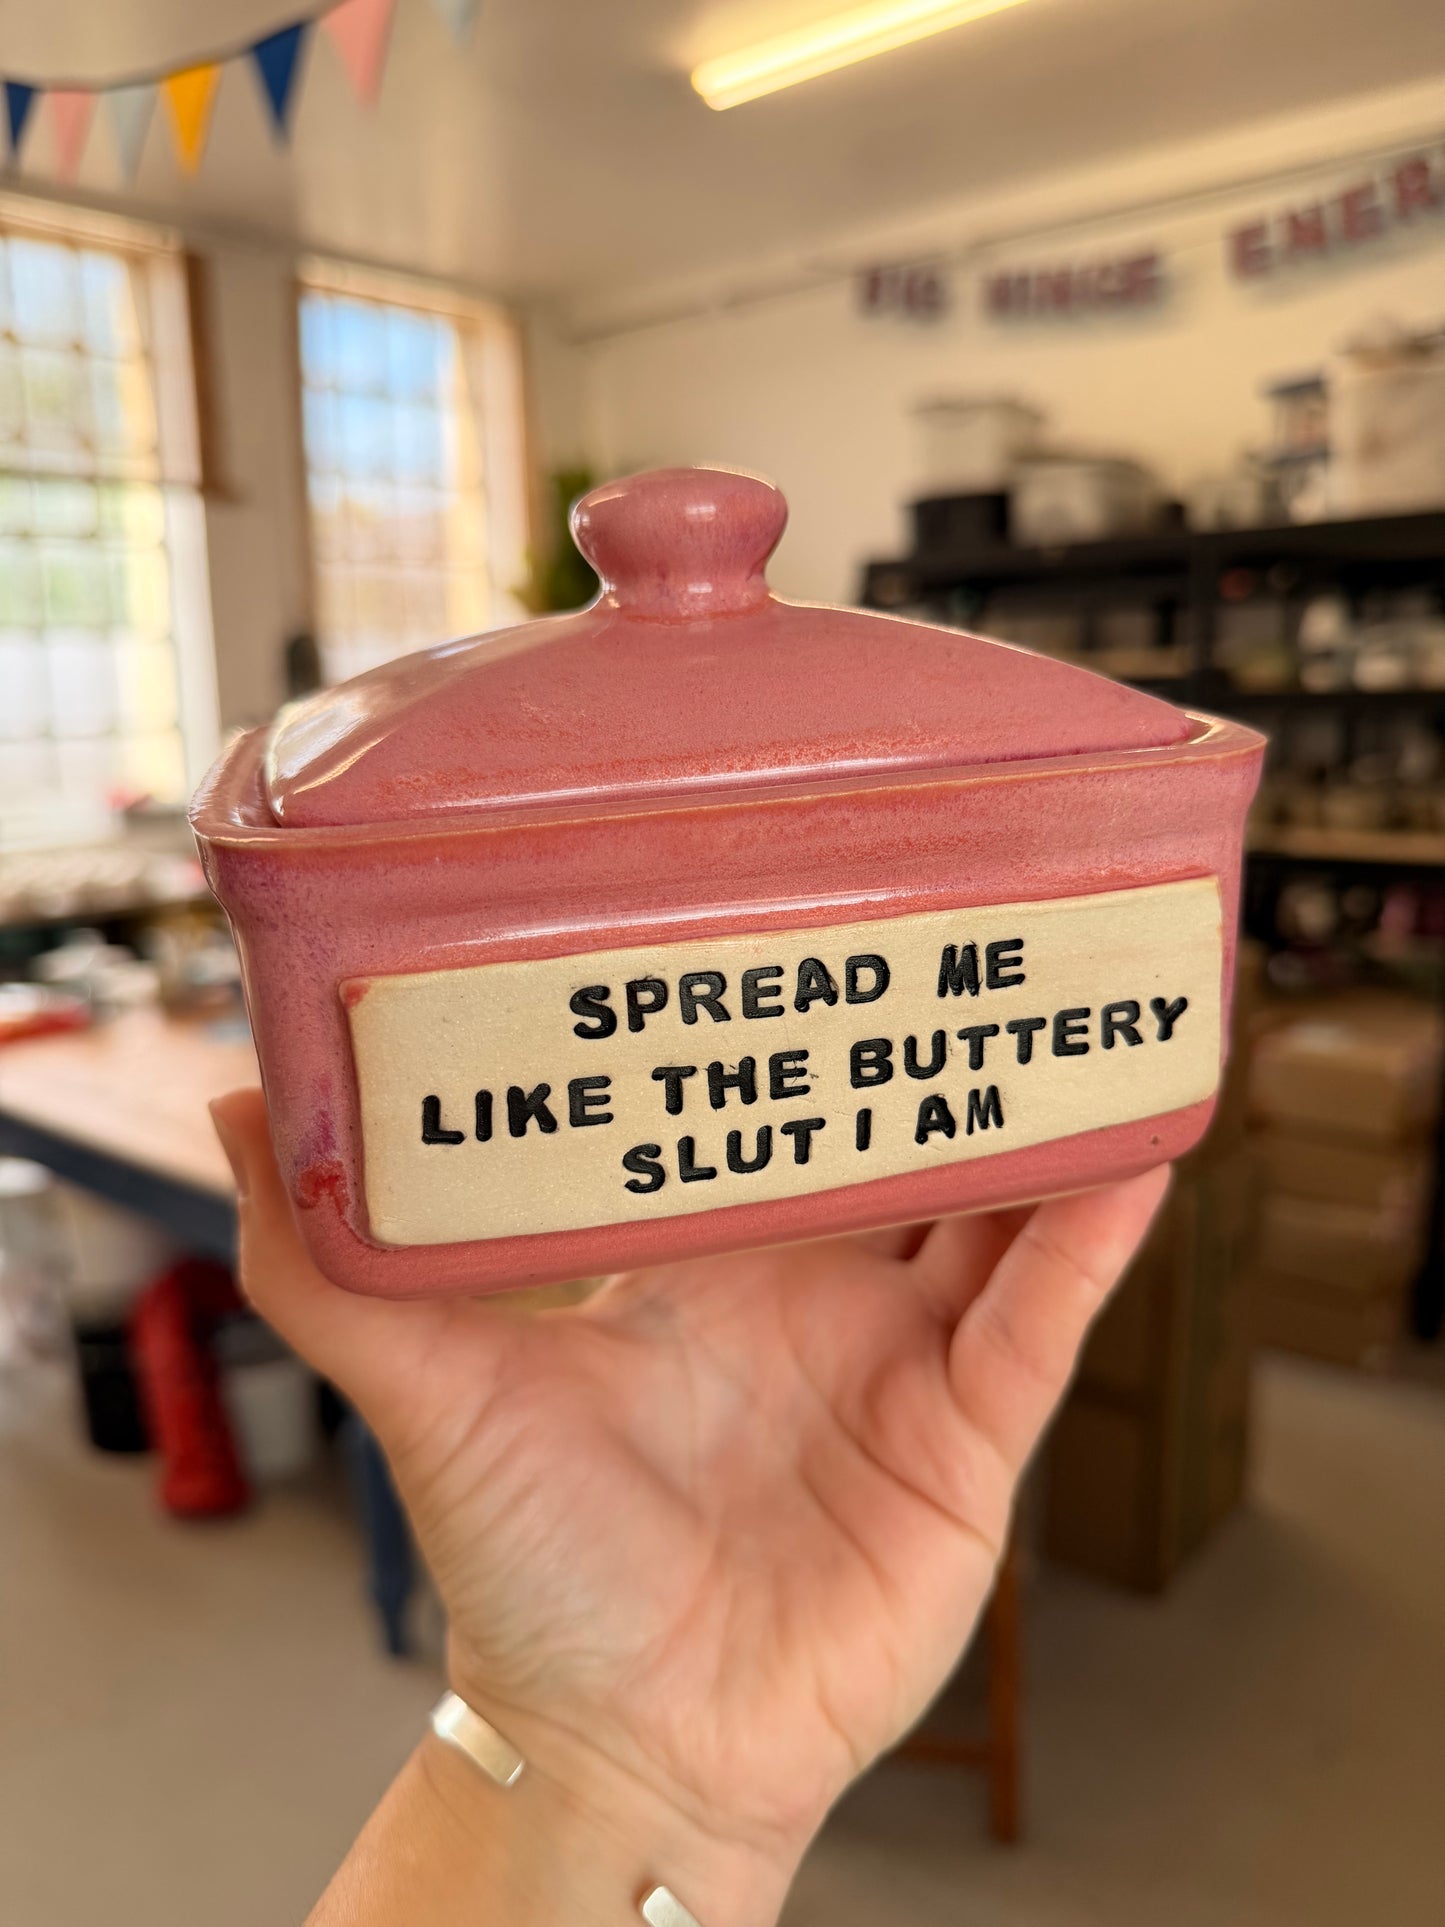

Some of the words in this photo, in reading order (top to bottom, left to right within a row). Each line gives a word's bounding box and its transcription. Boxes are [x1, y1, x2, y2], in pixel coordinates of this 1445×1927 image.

[568, 952, 892, 1041] SPREAD
[936, 937, 1027, 998] ME
[420, 1074, 616, 1147] LIKE
[650, 1048, 812, 1117] THE
[848, 995, 1190, 1091] BUTTERY
[621, 1116, 828, 1195] SLUT
[854, 1106, 874, 1153] I
[913, 1083, 1006, 1145] AM
